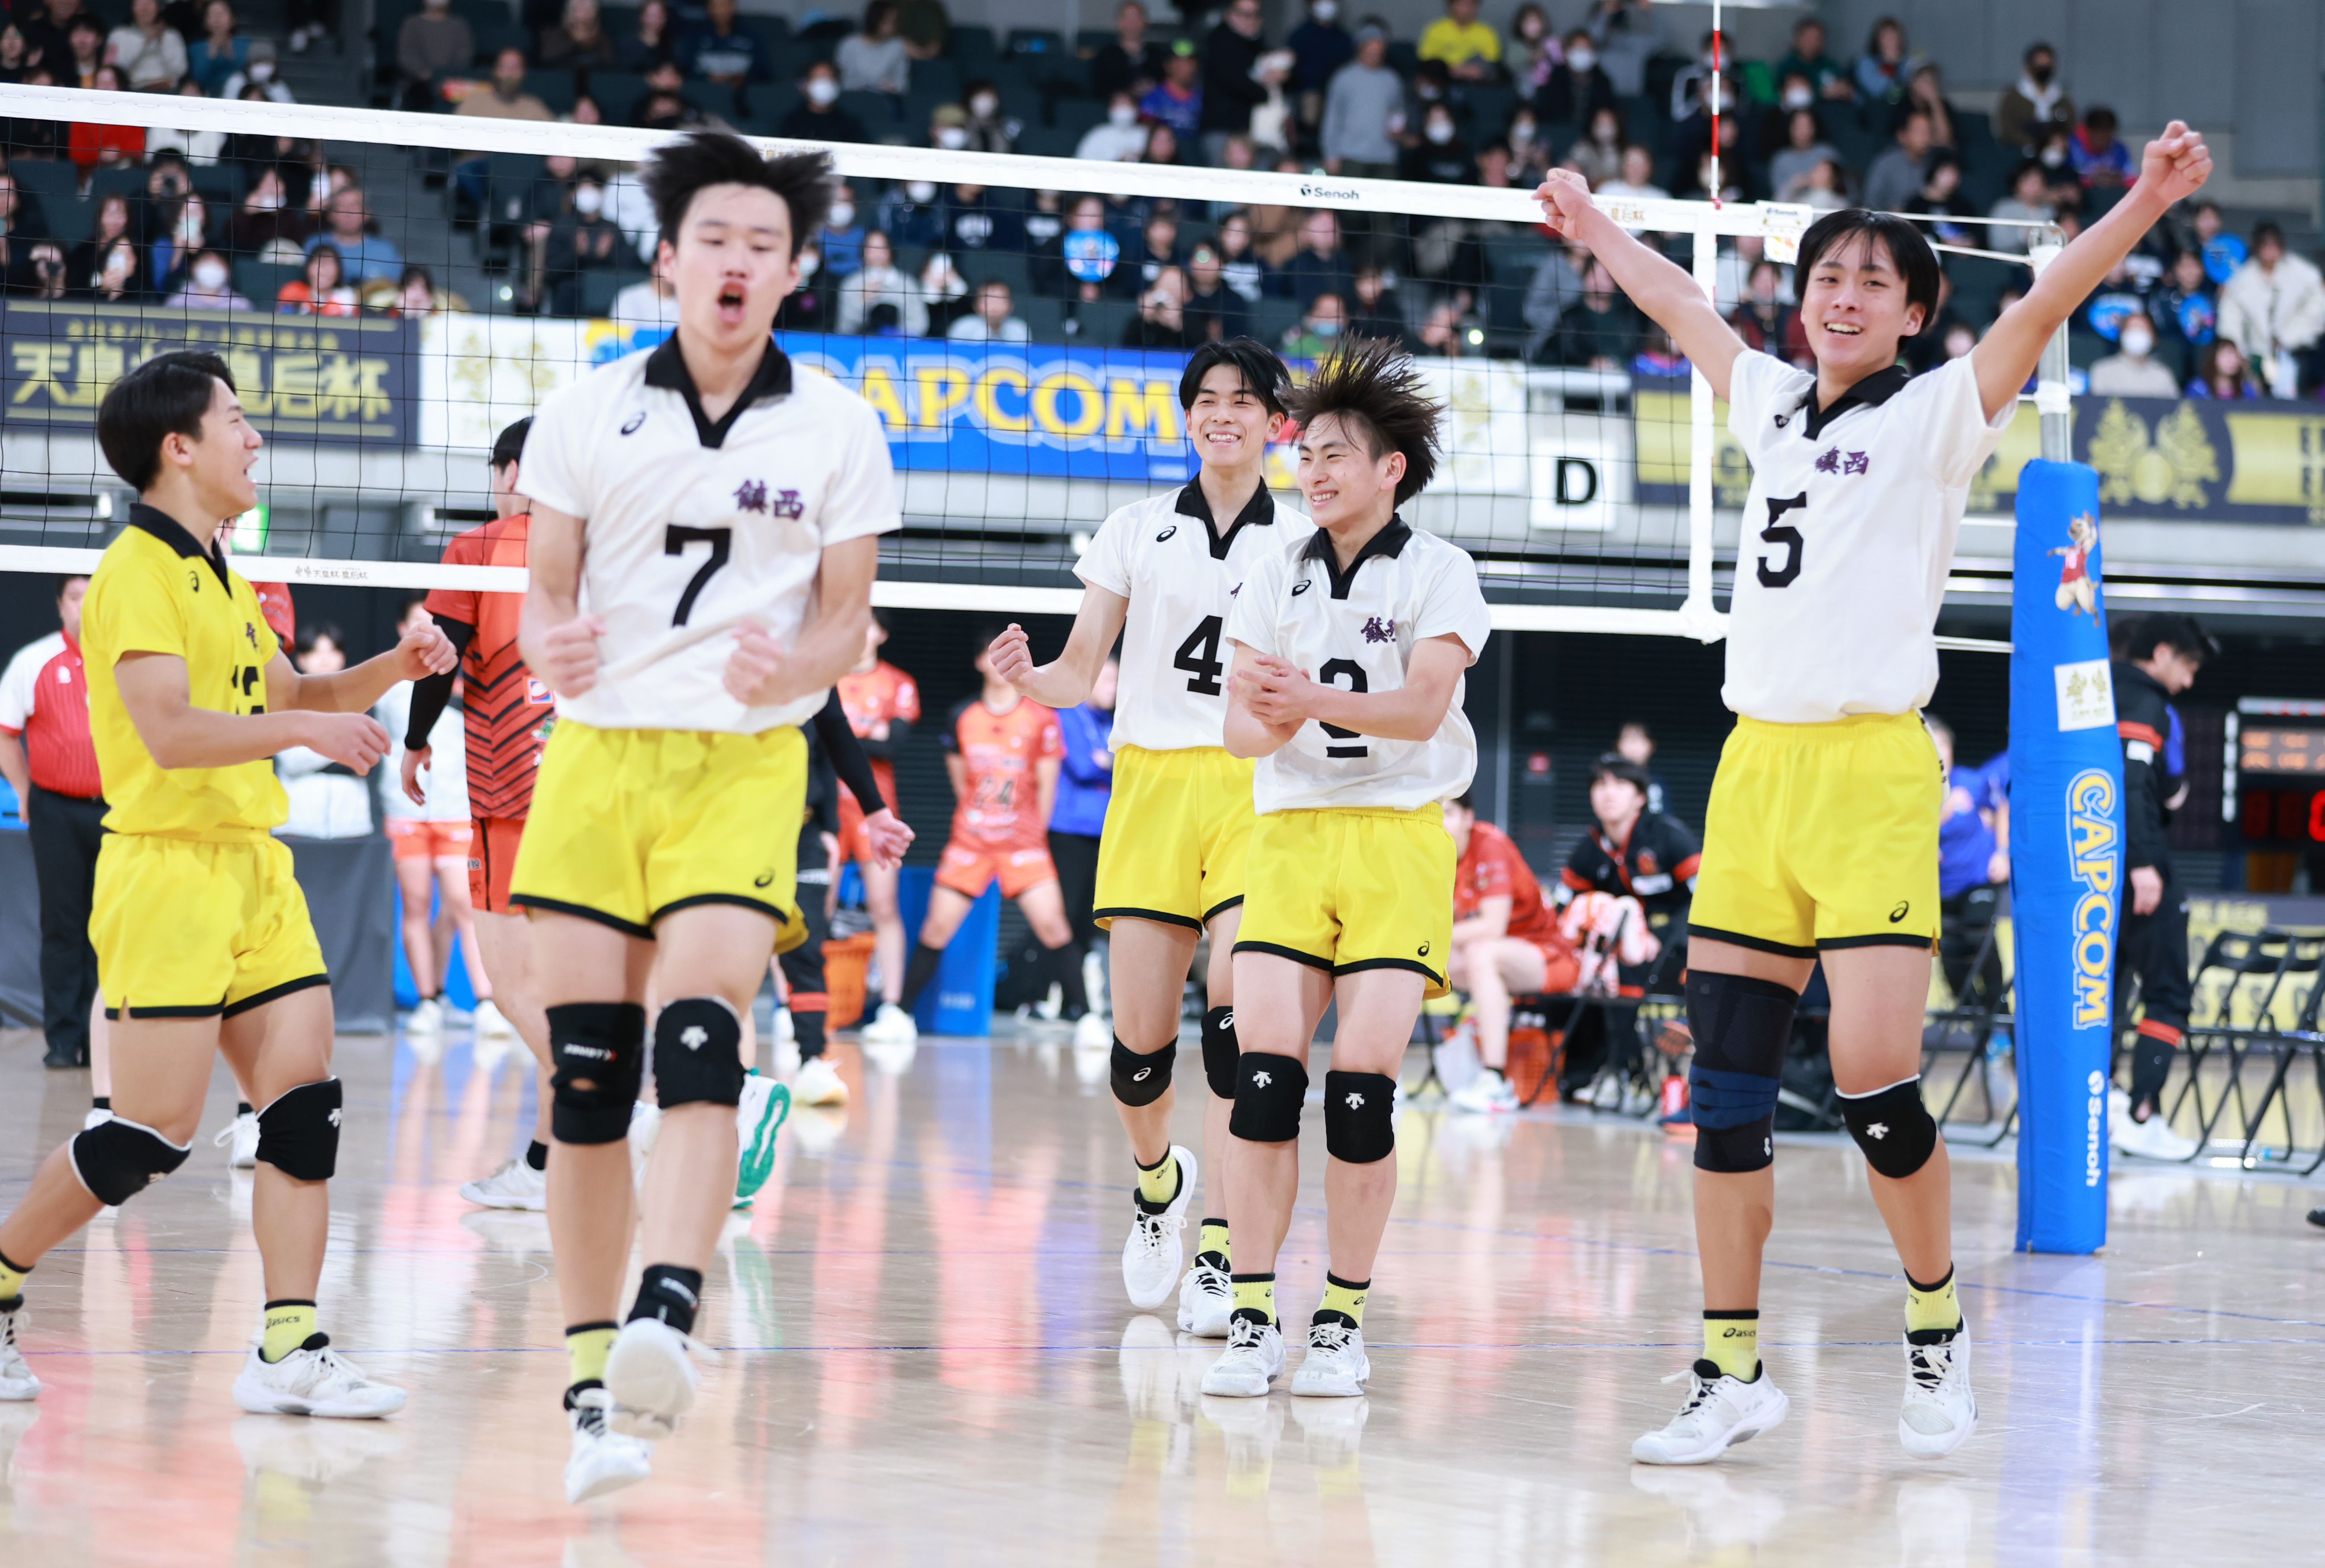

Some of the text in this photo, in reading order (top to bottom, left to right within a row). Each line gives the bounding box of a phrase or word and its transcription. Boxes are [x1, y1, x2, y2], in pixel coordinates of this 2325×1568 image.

[1314, 187, 1359, 200] Senoh
[803, 342, 1180, 444] APCOM
[1557, 459, 1597, 504] D
[665, 524, 731, 628] 7
[1757, 491, 1807, 588] 5
[1173, 615, 1223, 696] 4
[2069, 771, 2116, 1028] CAPCOM
[2086, 1095, 2103, 1187] Senoh
